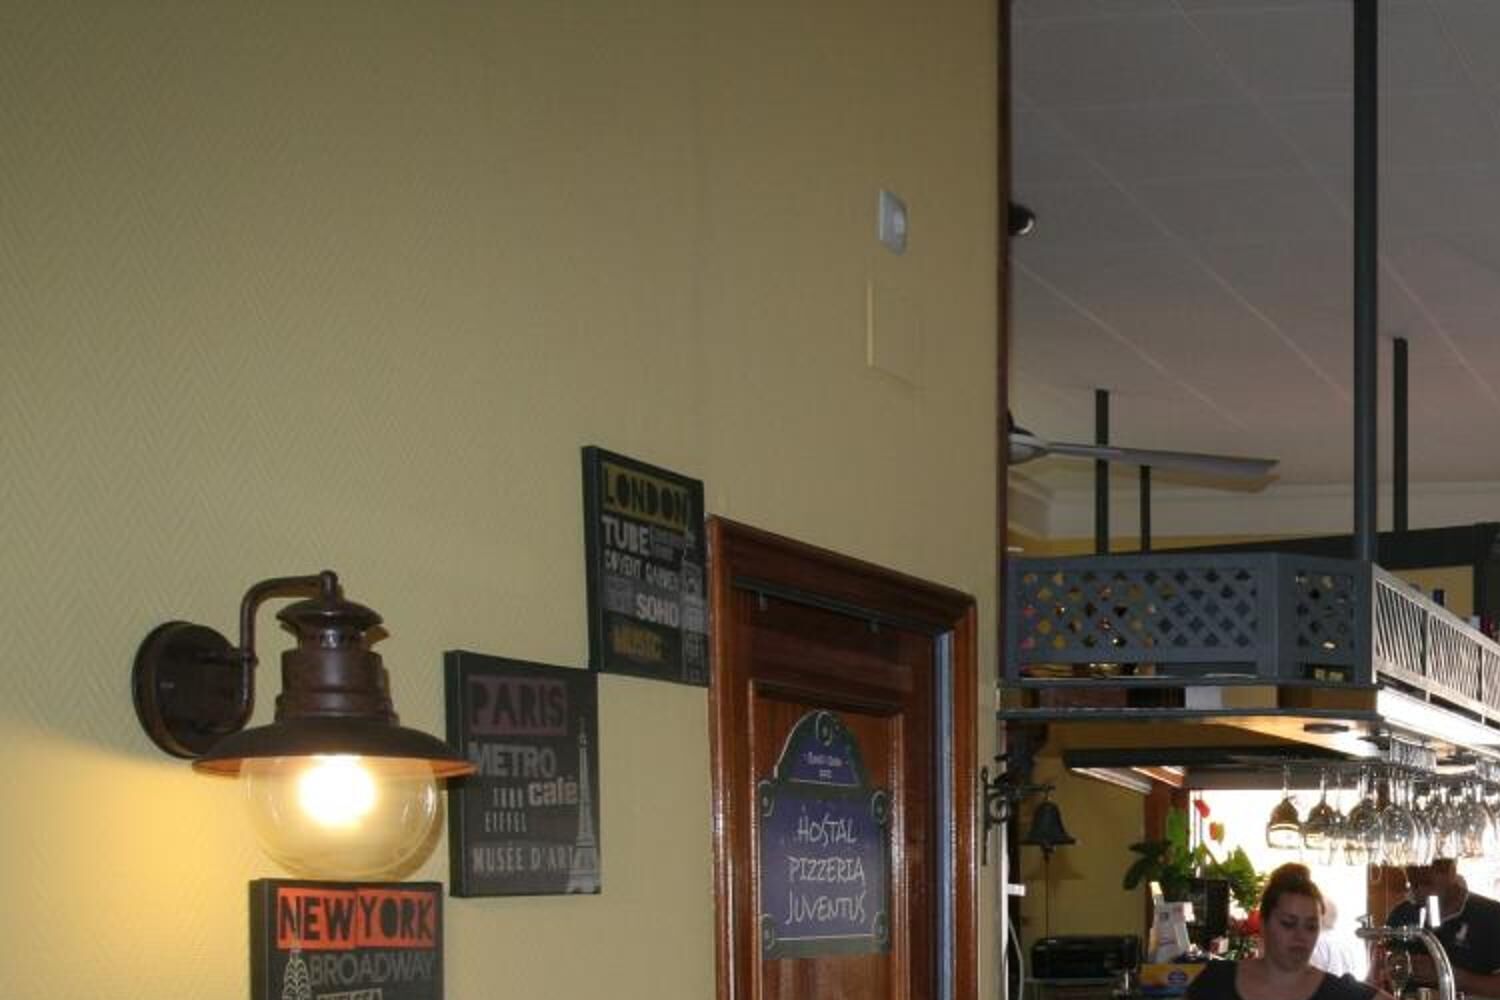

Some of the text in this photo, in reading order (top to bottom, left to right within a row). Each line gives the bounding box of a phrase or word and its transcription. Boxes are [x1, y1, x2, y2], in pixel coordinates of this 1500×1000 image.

[604, 466, 688, 526] LONDON
[601, 515, 650, 556] TUBE
[636, 592, 680, 627] SOHO
[470, 681, 565, 728] PARIS
[467, 742, 557, 778] METRO
[797, 811, 857, 847] HOSTAL
[786, 855, 866, 886] PIZZERIA
[785, 890, 867, 926] JUVENTUS
[310, 953, 433, 985] BROADWAY
